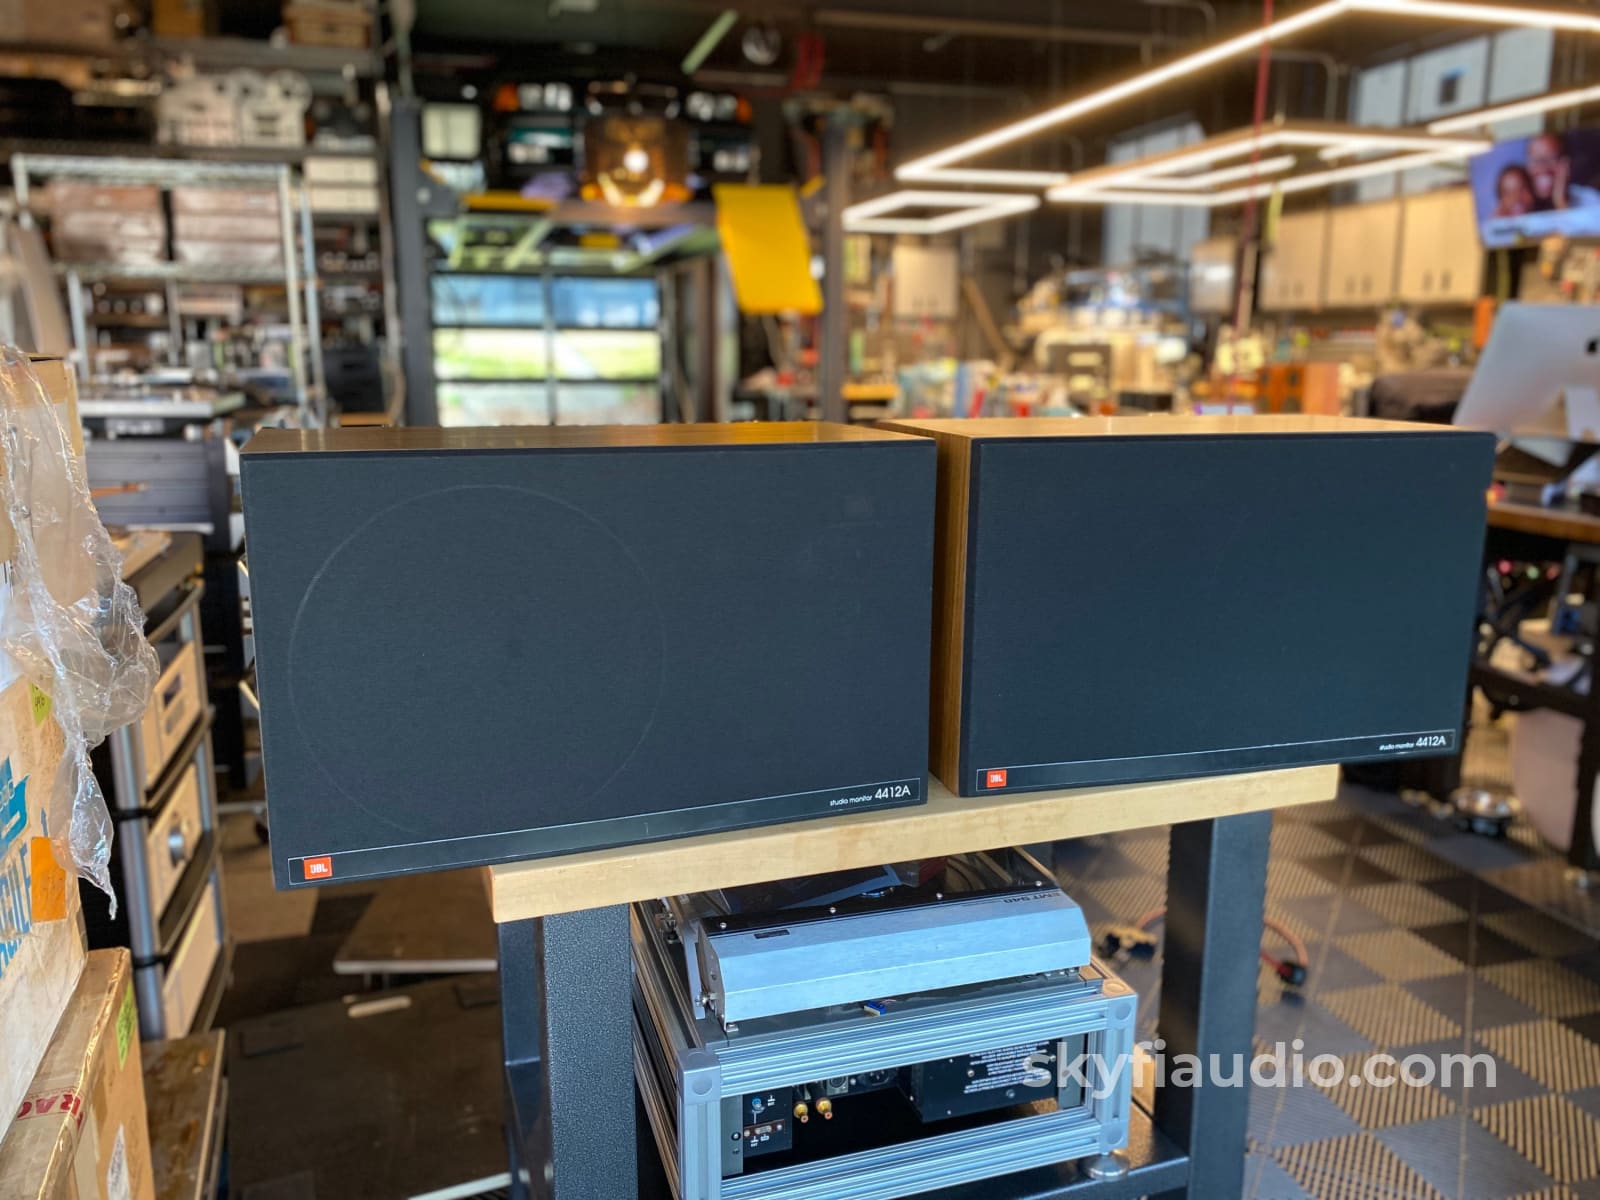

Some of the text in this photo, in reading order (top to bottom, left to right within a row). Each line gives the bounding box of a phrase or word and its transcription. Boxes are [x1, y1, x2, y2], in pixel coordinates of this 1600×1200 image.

[1415, 735, 1447, 747] 4412A
[829, 785, 911, 806] studio monitor 4412A
[310, 863, 328, 874] JBL
